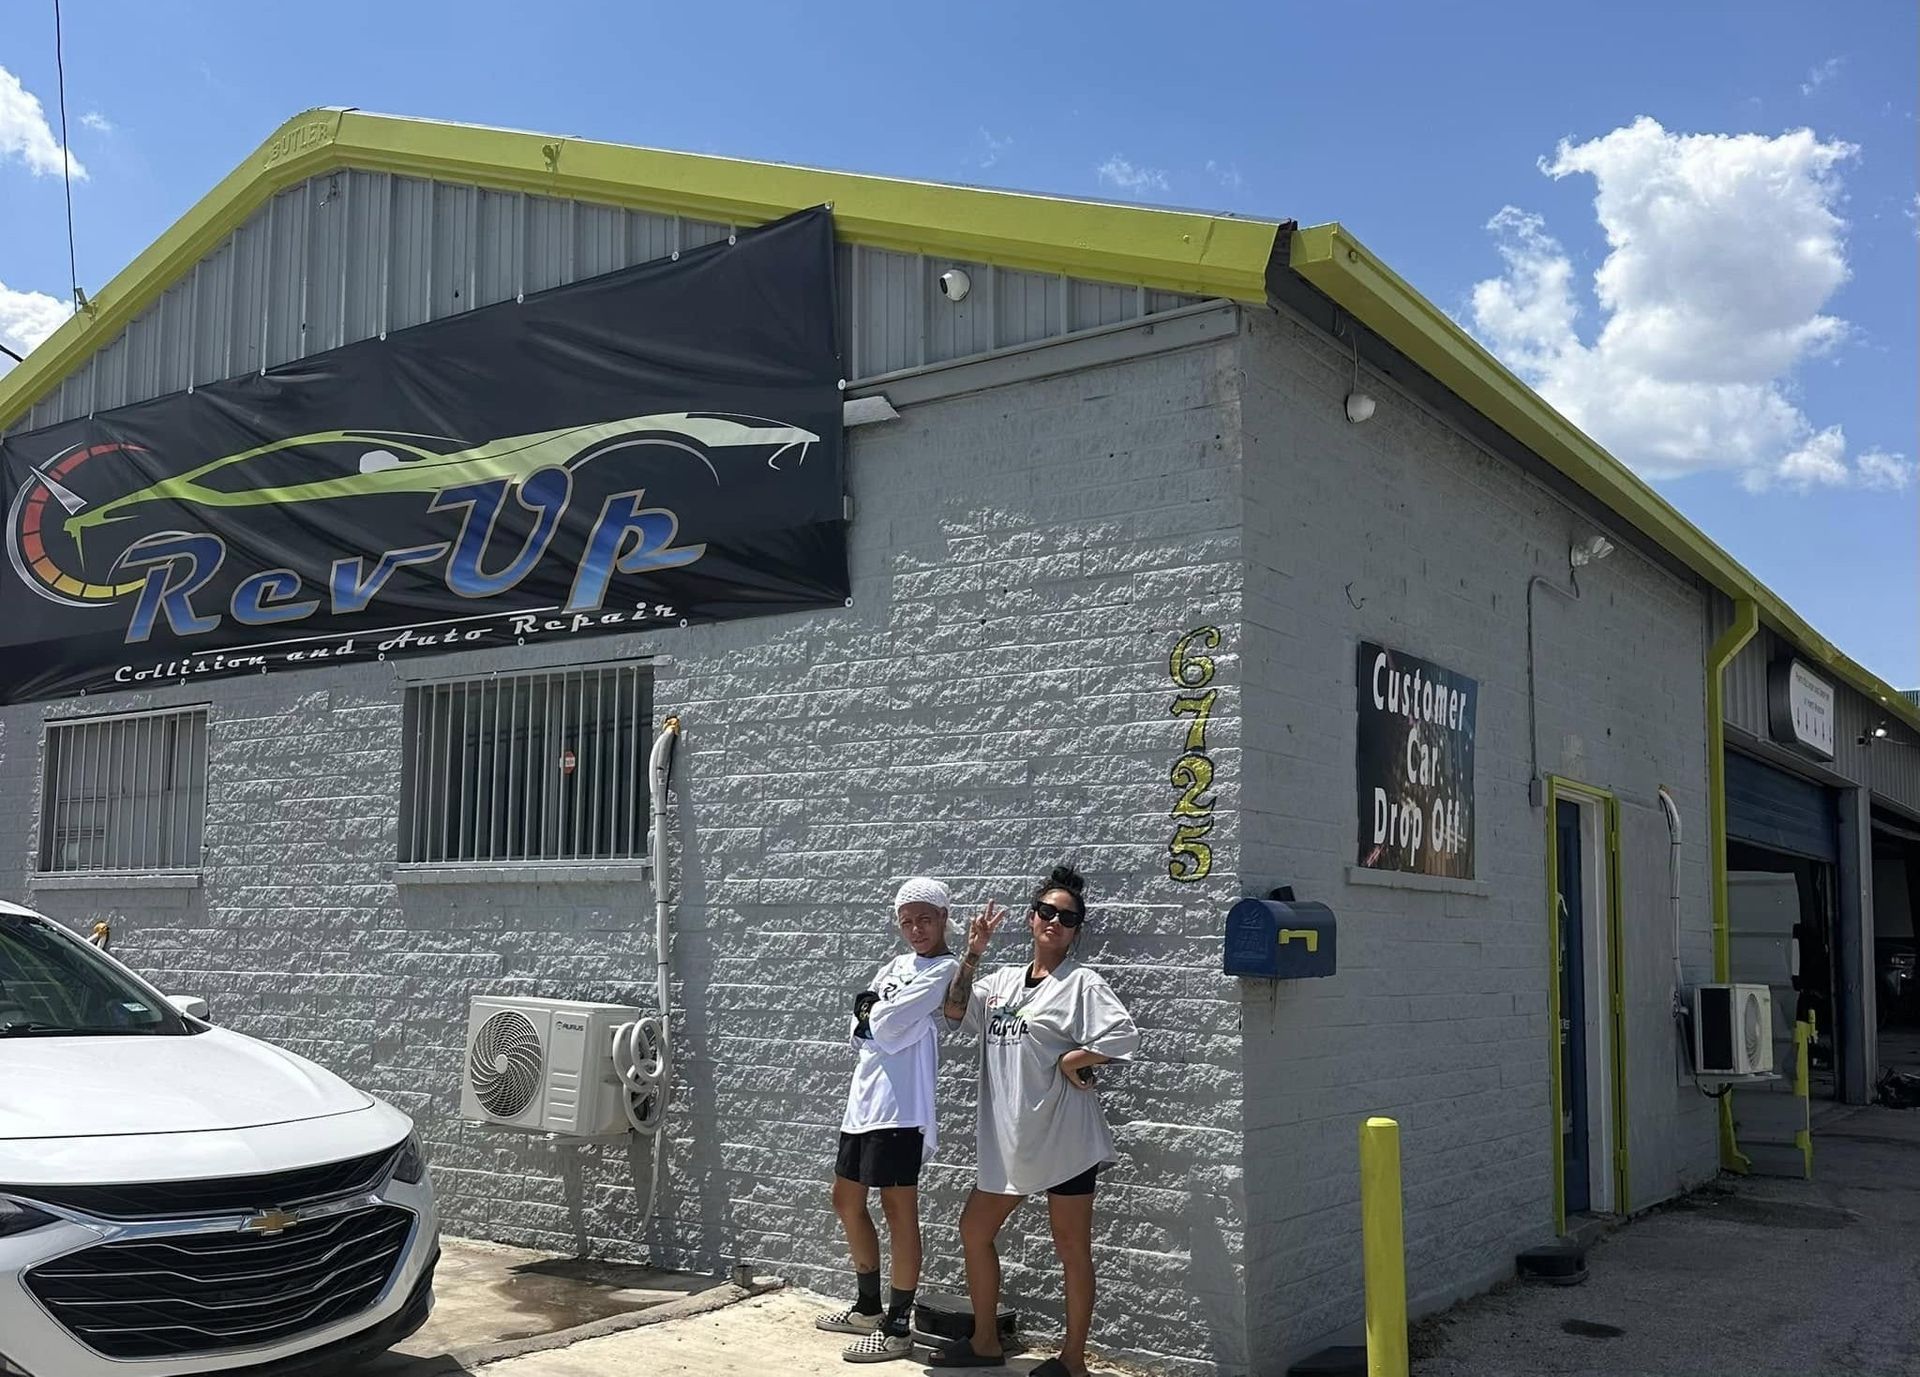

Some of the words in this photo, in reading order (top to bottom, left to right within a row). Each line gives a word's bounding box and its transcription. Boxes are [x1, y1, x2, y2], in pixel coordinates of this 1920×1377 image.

[270, 122, 328, 161] BUTLER
[114, 655, 267, 684] Collision
[286, 639, 356, 662] and
[378, 625, 493, 652] Auto
[508, 602, 678, 636] Repair
[1373, 652, 1467, 732] Customer
[1168, 625, 1221, 882] 6725
[1406, 728, 1438, 787] Car
[1373, 787, 1422, 867] Drop
[1431, 797, 1460, 854] Off
